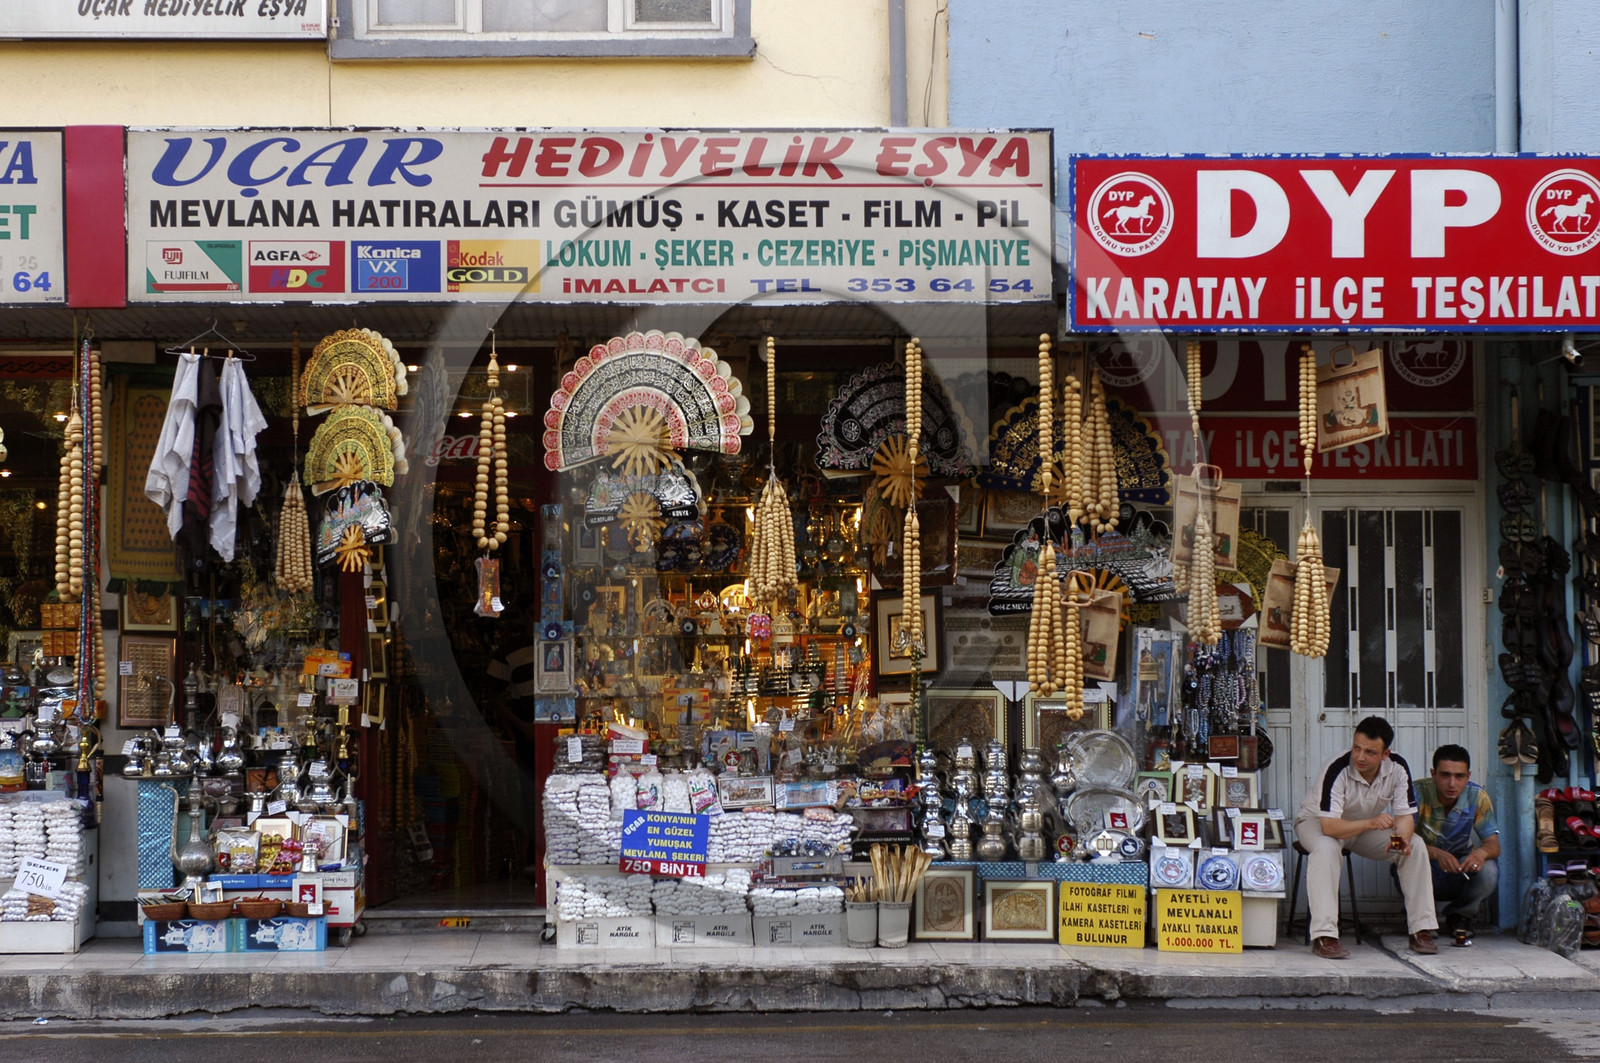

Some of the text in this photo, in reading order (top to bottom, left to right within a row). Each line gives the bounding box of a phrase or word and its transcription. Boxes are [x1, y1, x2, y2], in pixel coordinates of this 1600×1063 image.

[152, 137, 443, 197] UÇAR
[876, 137, 1030, 188] EŞYA
[1108, 191, 1135, 201] DYP
[1546, 189, 1573, 200] DYP
[150, 200, 320, 227] MEVLANA
[332, 200, 540, 227] HATIRALARI
[553, 194, 683, 231] GÜMÜŞ
[718, 200, 829, 227] KASET
[1196, 169, 1502, 258] DYP
[254, 250, 301, 261] AGFA
[357, 245, 422, 259] Konica
[546, 240, 632, 266] LOKUM
[655, 239, 735, 270] ŞEKER
[1119, 246, 1137, 254] YOL
[460, 252, 504, 266] Kodak
[369, 261, 398, 273] VX
[13, 271, 51, 292] 64
[164, 271, 209, 280] FUJIFILM
[269, 269, 327, 288] HDC
[447, 269, 523, 282] GOLD
[368, 276, 403, 289] 200
[750, 279, 822, 293] TEL
[848, 278, 916, 292] 353
[929, 278, 975, 292] 64
[989, 278, 1033, 292] 54
[1086, 277, 1267, 319] KARATAY
[624, 816, 646, 835] UÇAR
[647, 813, 697, 825] KONYA'NIN
[647, 825, 694, 837] EN GÜZEL
[648, 838, 692, 849] YUMUŞAK
[623, 848, 667, 859] MEVLANA
[624, 859, 652, 872] 750
[686, 864, 700, 876] TL
[21, 870, 45, 888] 750
[1167, 908, 1232, 919] MEVLANALI
[1061, 917, 1094, 928] KAMERA
[1162, 923, 1238, 935] AYAKLI TABAKLAR
[1076, 932, 1128, 944] BULUNUR
[1166, 936, 1214, 948] 1.000.000
